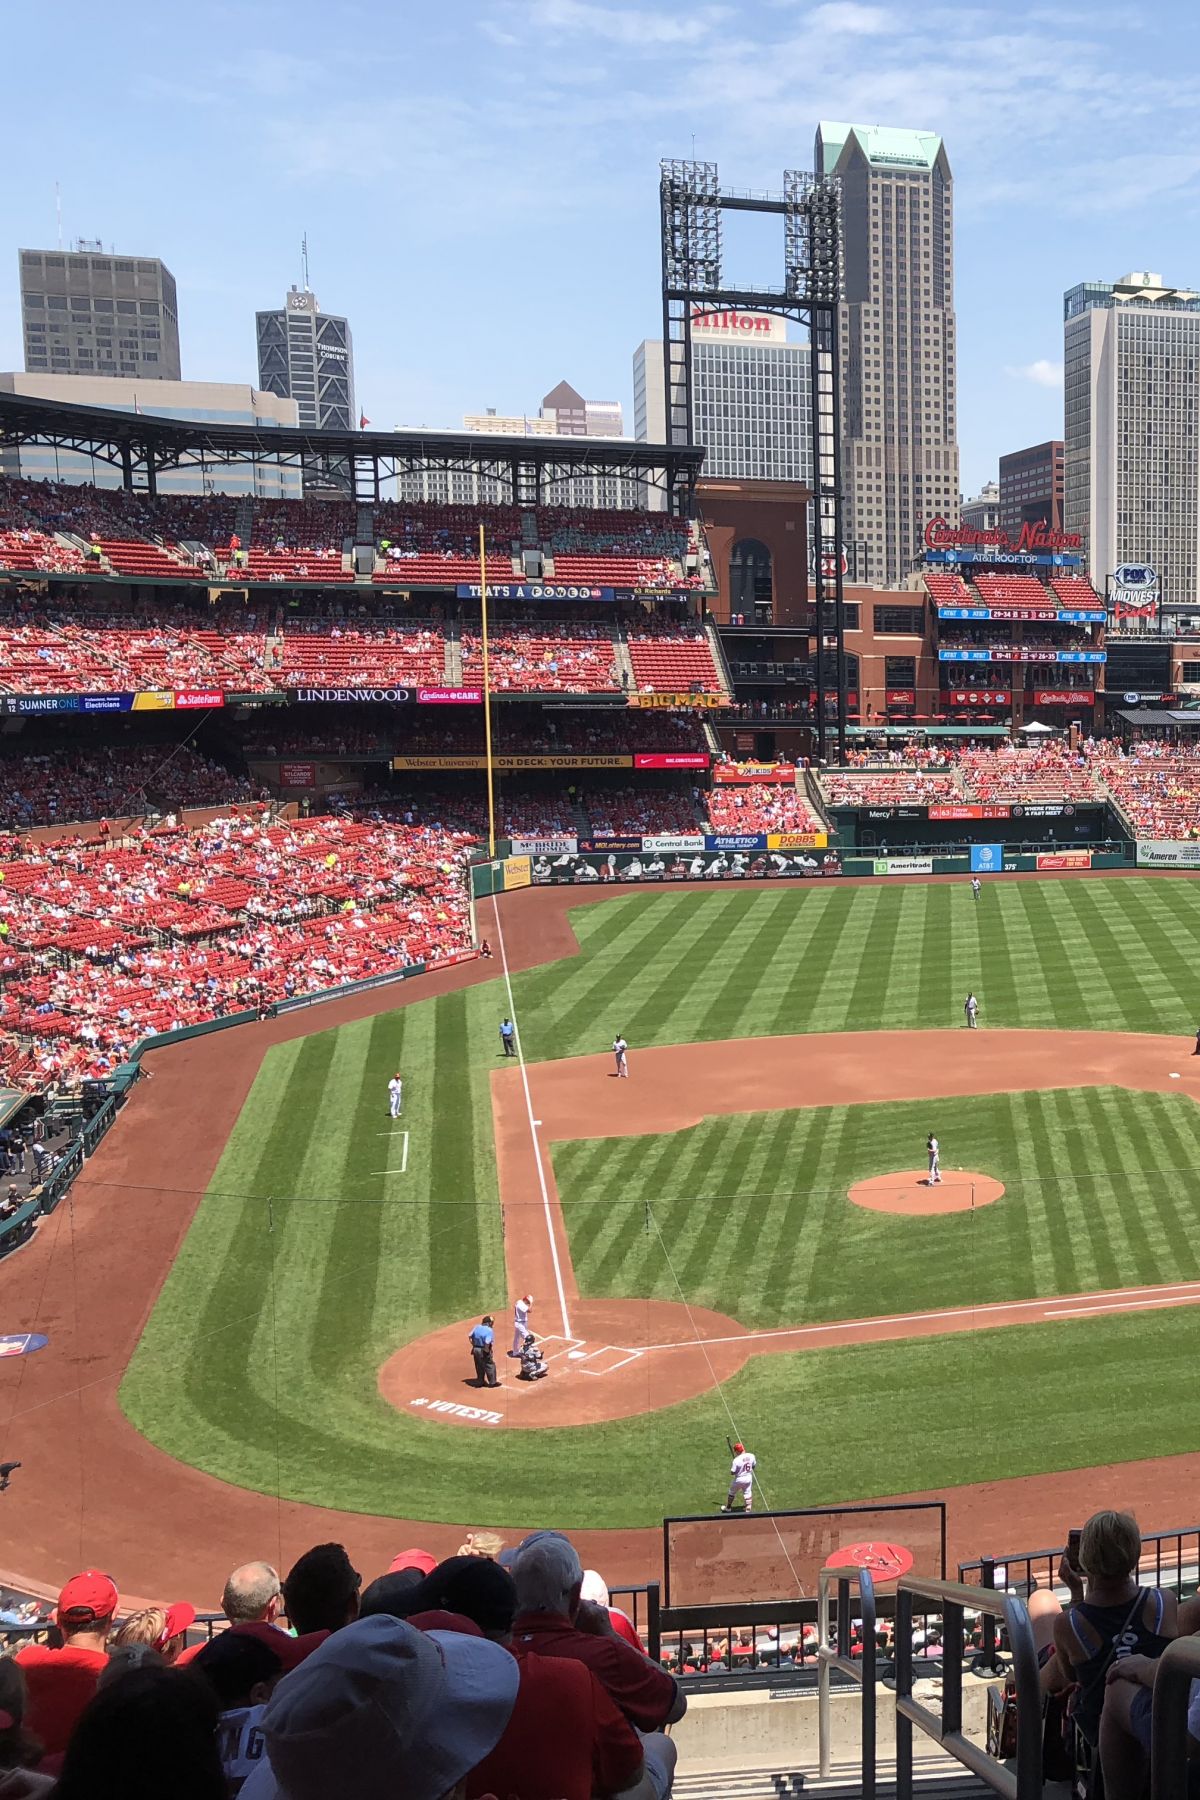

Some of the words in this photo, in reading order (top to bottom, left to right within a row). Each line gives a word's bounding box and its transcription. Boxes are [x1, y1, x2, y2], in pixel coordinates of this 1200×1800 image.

[693, 308, 771, 331] Hilton
[317, 344, 347, 354] THOMPSON
[320, 350, 345, 361] COBURN
[926, 517, 1009, 549] Cardinals
[1010, 521, 1081, 550] Nation
[972, 554, 994, 563] AT&T
[995, 554, 1038, 563] ROOFTOP
[1123, 569, 1147, 580] FOX
[516, 586, 525, 597] A
[1110, 590, 1160, 602] MIDWEST
[1115, 601, 1156, 621] Live!
[297, 689, 409, 701] LINDENWOOD
[420, 690, 450, 701] Cardinals
[639, 694, 672, 708] BIG
[675, 693, 719, 708] MAC
[19, 699, 58, 710] SUMNER
[59, 698, 79, 709] ONE
[85, 701, 120, 709] Electricians
[405, 758, 438, 767] Webster
[440, 758, 480, 768] University
[498, 758, 511, 766] ON
[514, 758, 548, 766] DECK:
[550, 757, 578, 766] YOUR
[583, 757, 624, 766] FUTURE.
[869, 810, 890, 819] Mercy
[686, 839, 704, 847] Bank
[714, 836, 759, 845] ATHLETICO
[780, 835, 816, 844] DOBBS
[1149, 852, 1177, 861] Ameren
